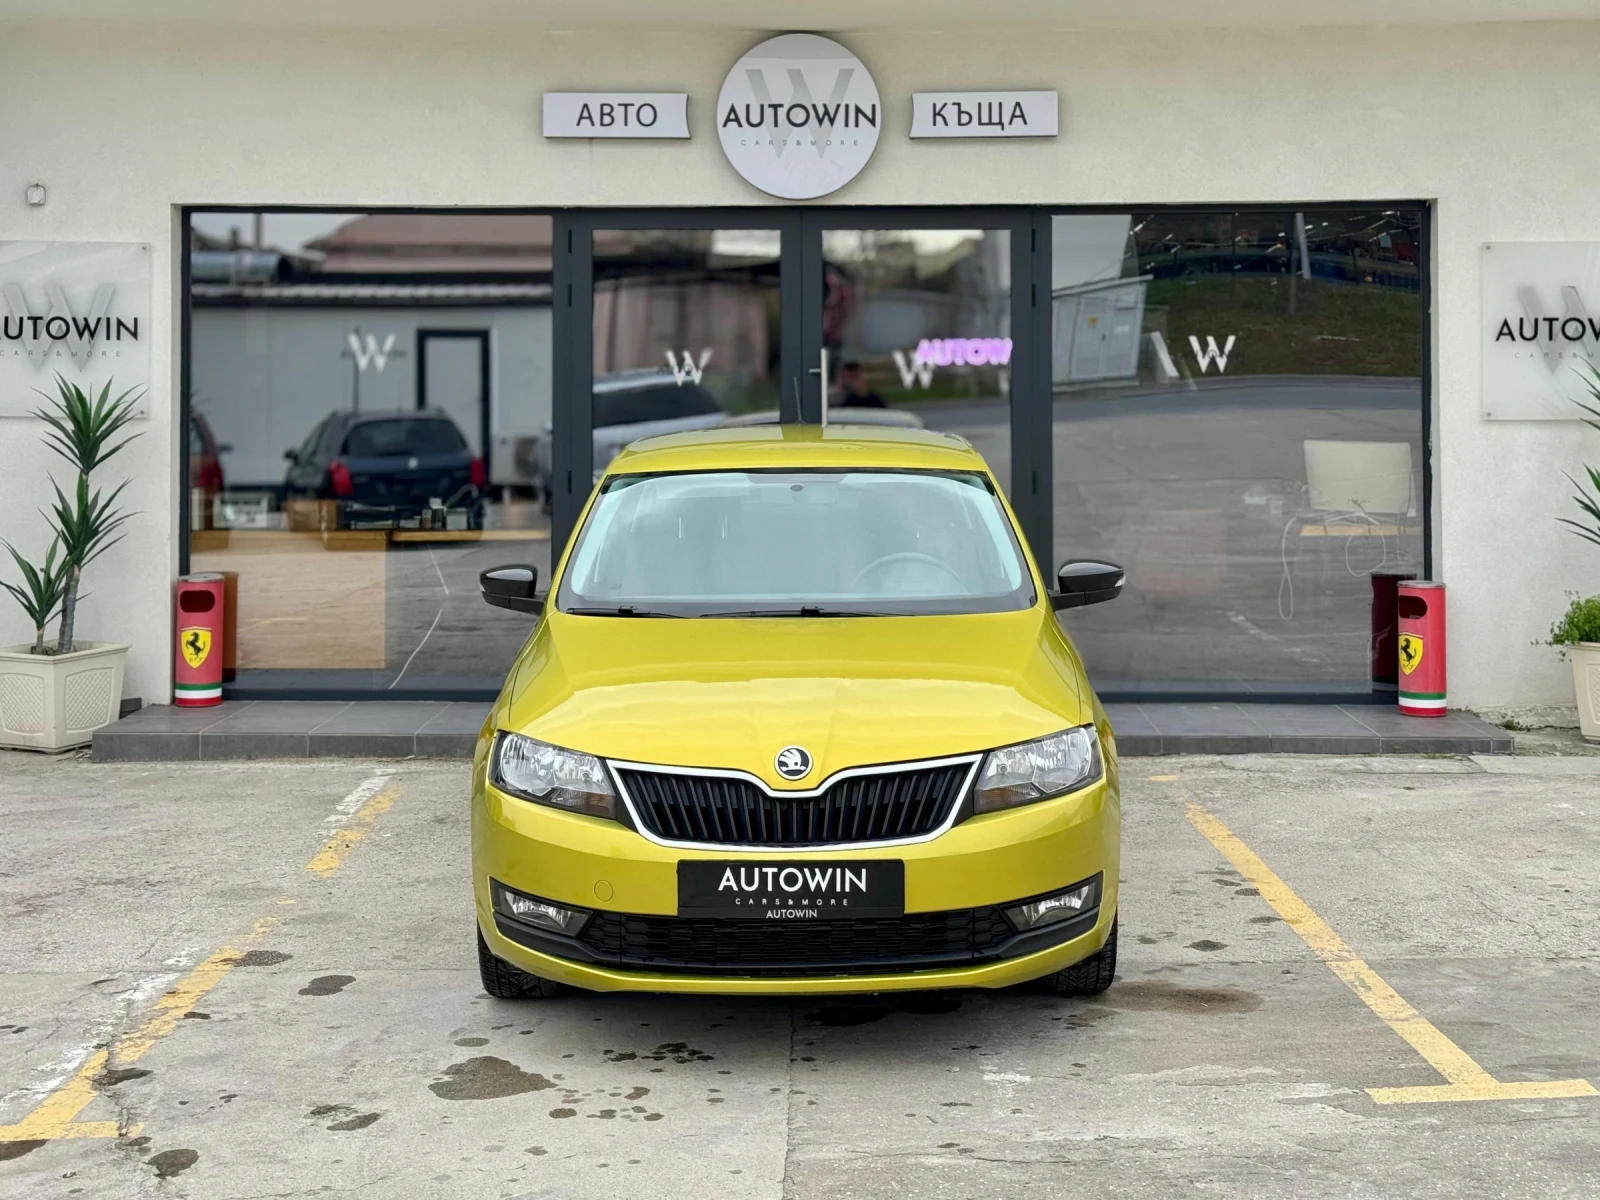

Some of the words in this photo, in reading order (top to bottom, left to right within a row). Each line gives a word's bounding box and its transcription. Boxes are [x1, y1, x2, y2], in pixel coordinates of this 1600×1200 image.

[576, 103, 658, 127] АВТО
[722, 103, 877, 128] AUTOWIN
[745, 68, 855, 160] W
[932, 101, 1028, 130] КЪЩА
[0, 316, 139, 341] UTOWIN
[348, 333, 397, 373] W
[1188, 335, 1236, 374] W
[666, 348, 713, 387] W
[718, 867, 867, 893] AUTOWIN
[735, 898, 848, 906] CARS&MORE
[766, 909, 818, 919] AUTOWIN
